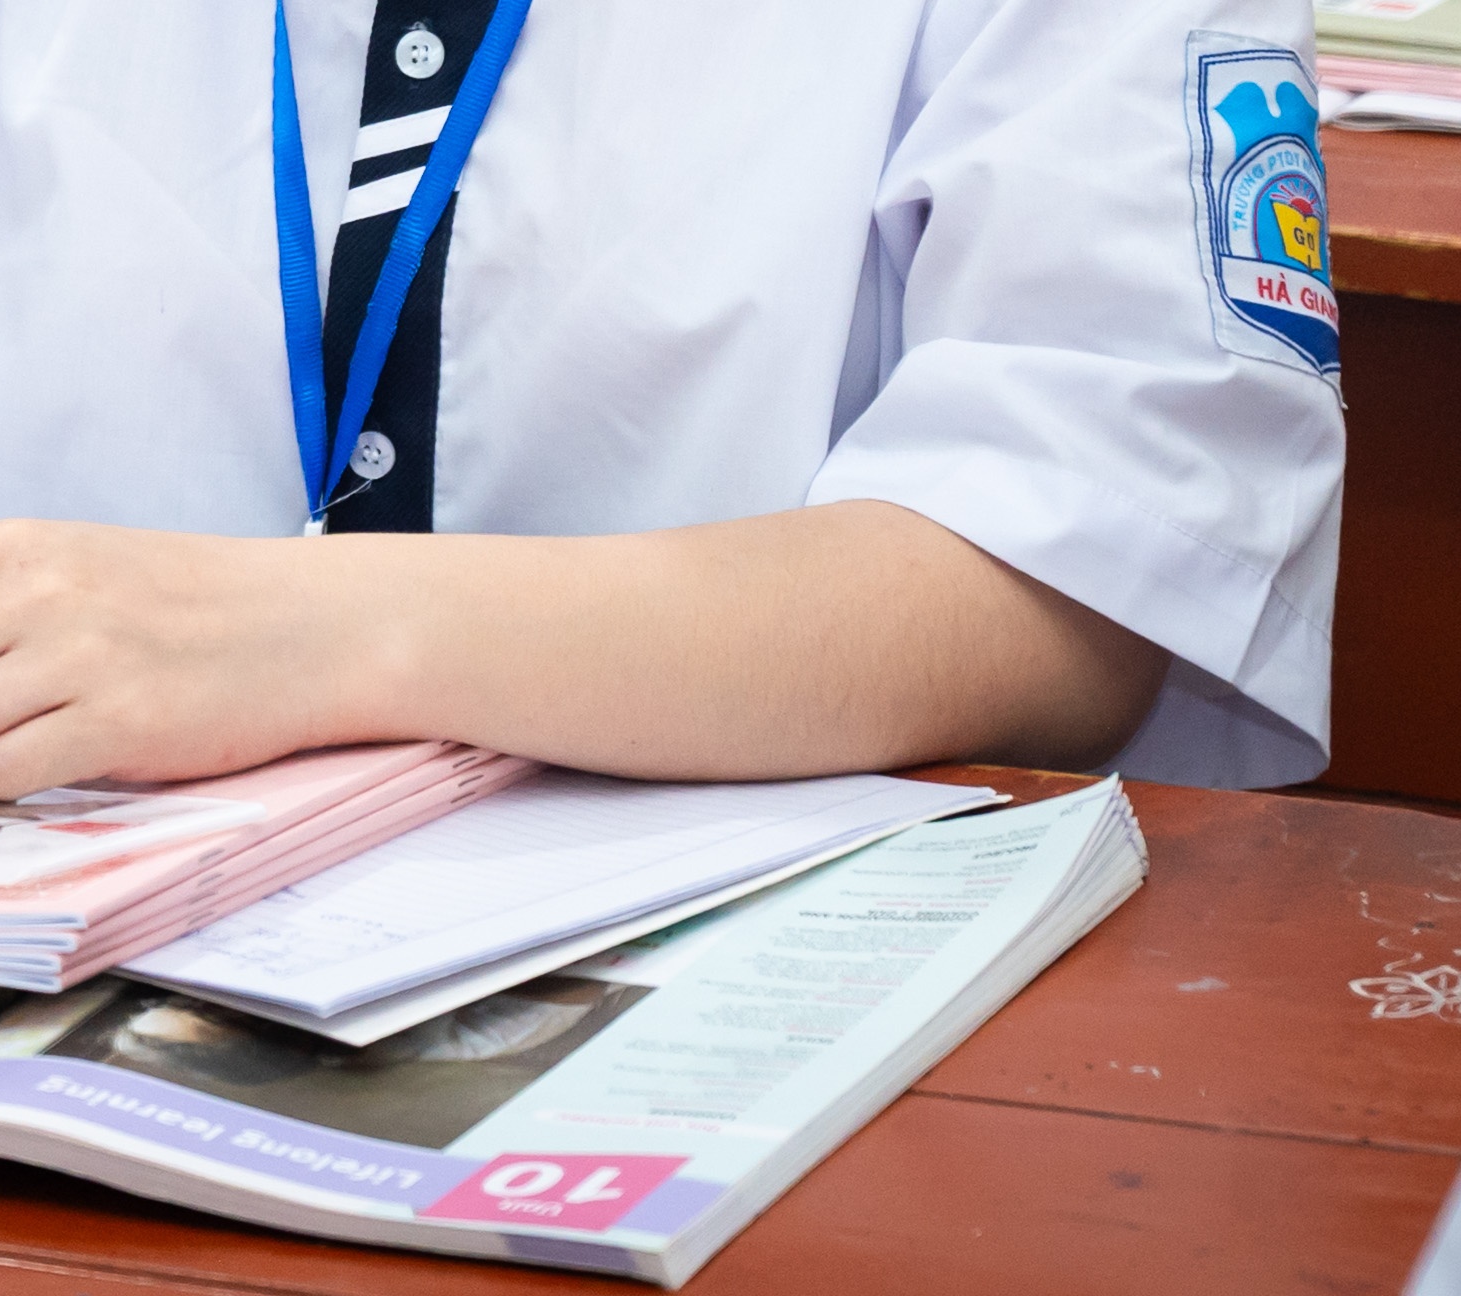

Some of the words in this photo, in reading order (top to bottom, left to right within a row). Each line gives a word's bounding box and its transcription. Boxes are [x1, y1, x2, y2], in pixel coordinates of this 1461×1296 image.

[1257, 272, 1293, 306] HÀ
[1300, 286, 1339, 323] GIAN
[35, 1074, 226, 1142] learning
[230, 1127, 424, 1190] Lifelong
[480, 1160, 626, 1204] 10
